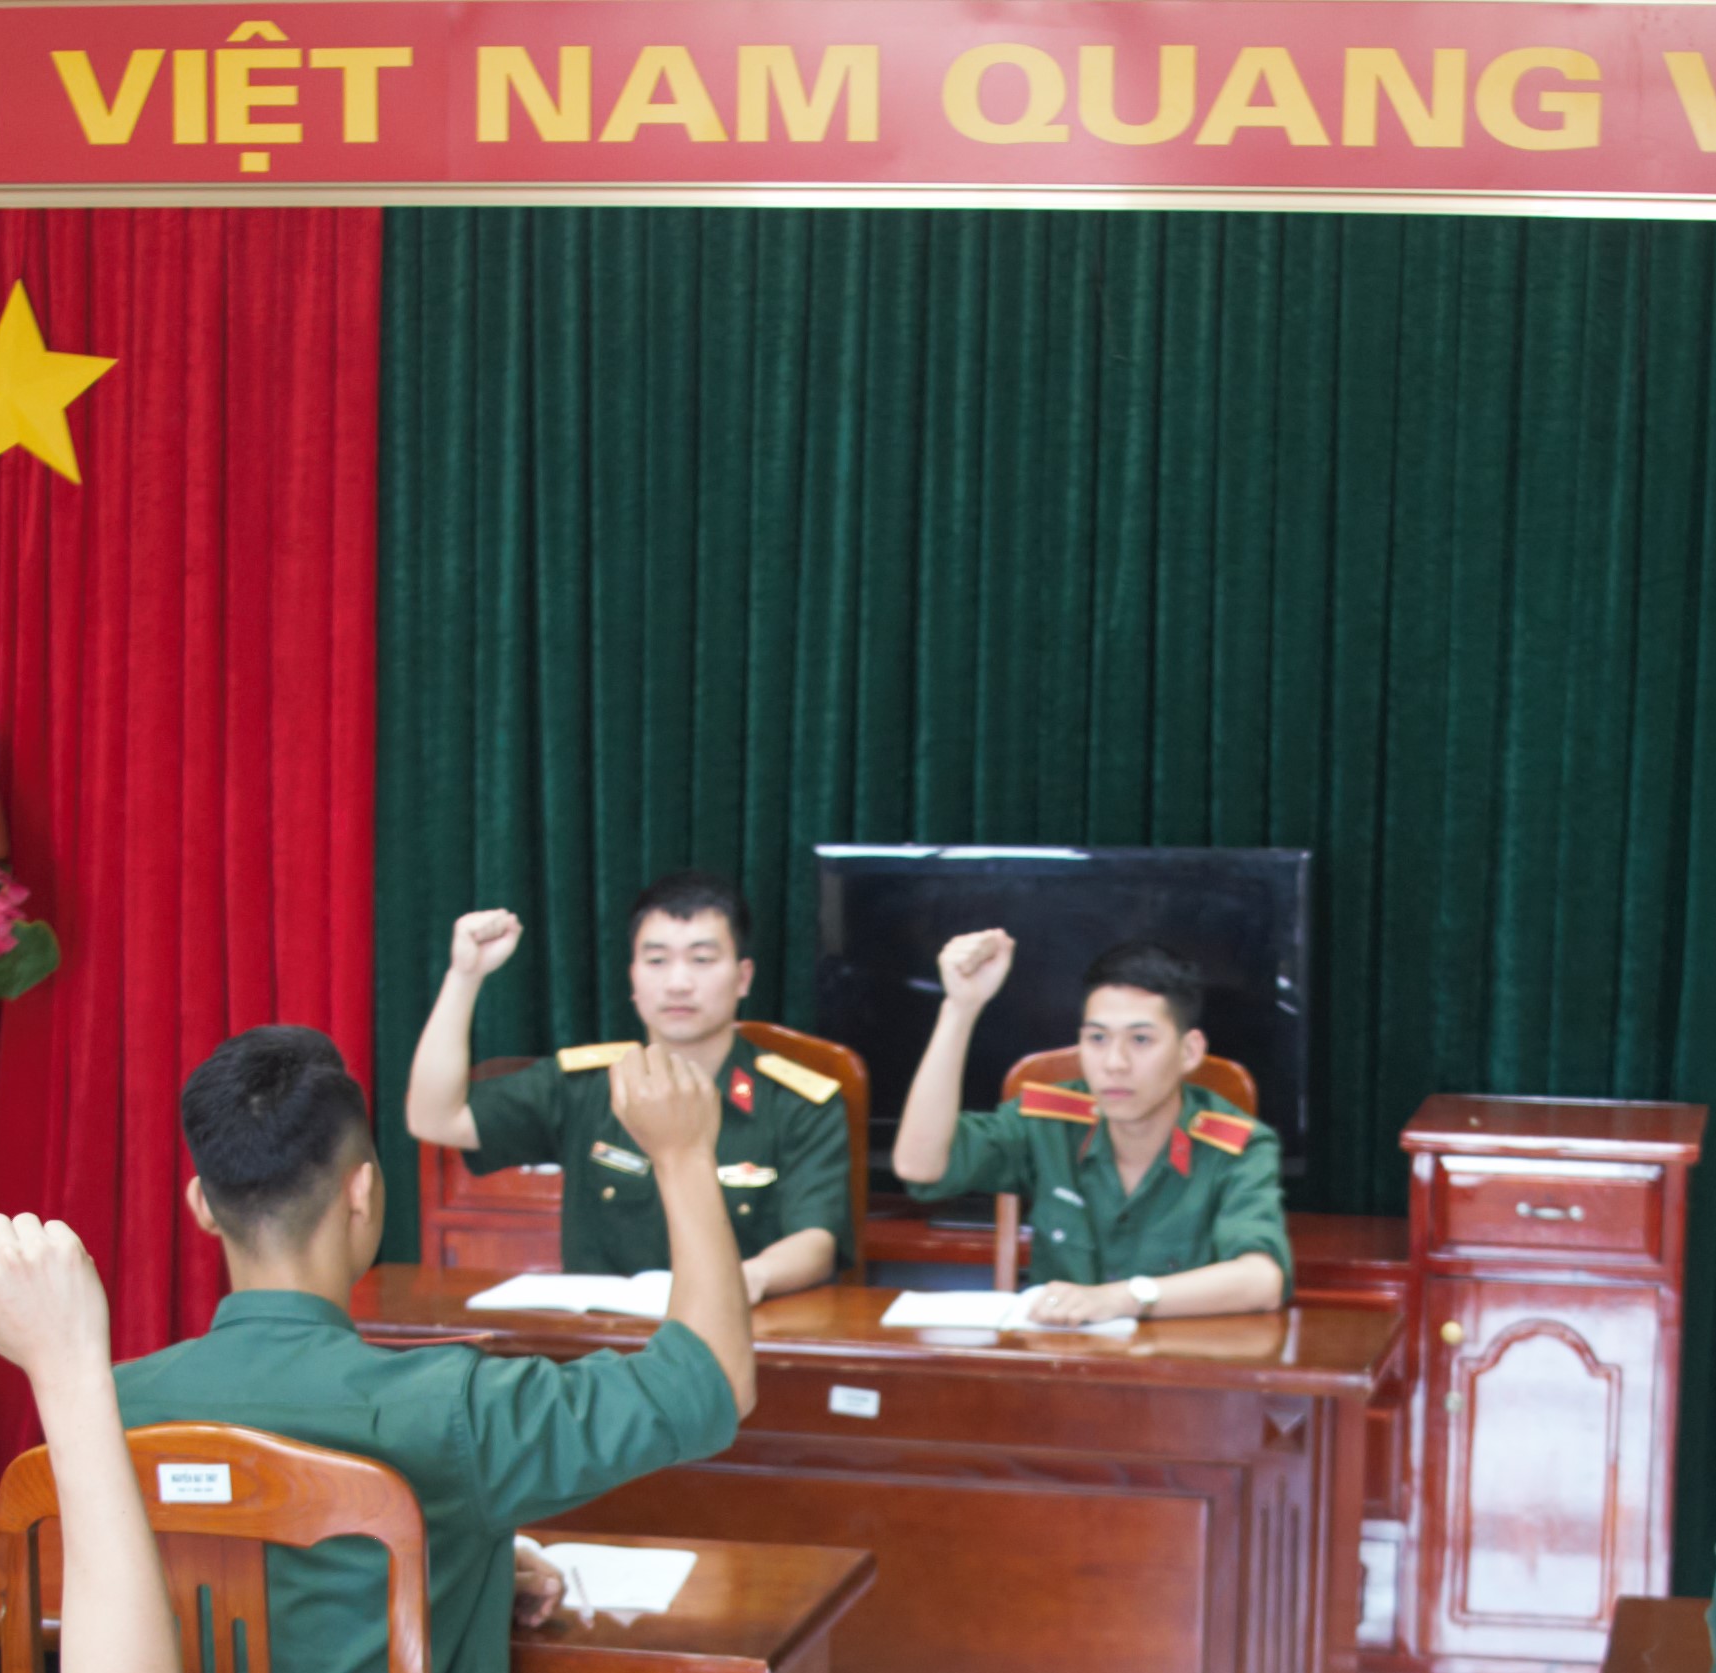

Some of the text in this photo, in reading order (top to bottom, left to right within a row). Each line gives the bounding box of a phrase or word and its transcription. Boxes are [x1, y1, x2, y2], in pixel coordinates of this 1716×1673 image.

[51, 21, 414, 173] VIỆT
[475, 44, 880, 143] NAM
[941, 43, 1602, 151] QUANG
